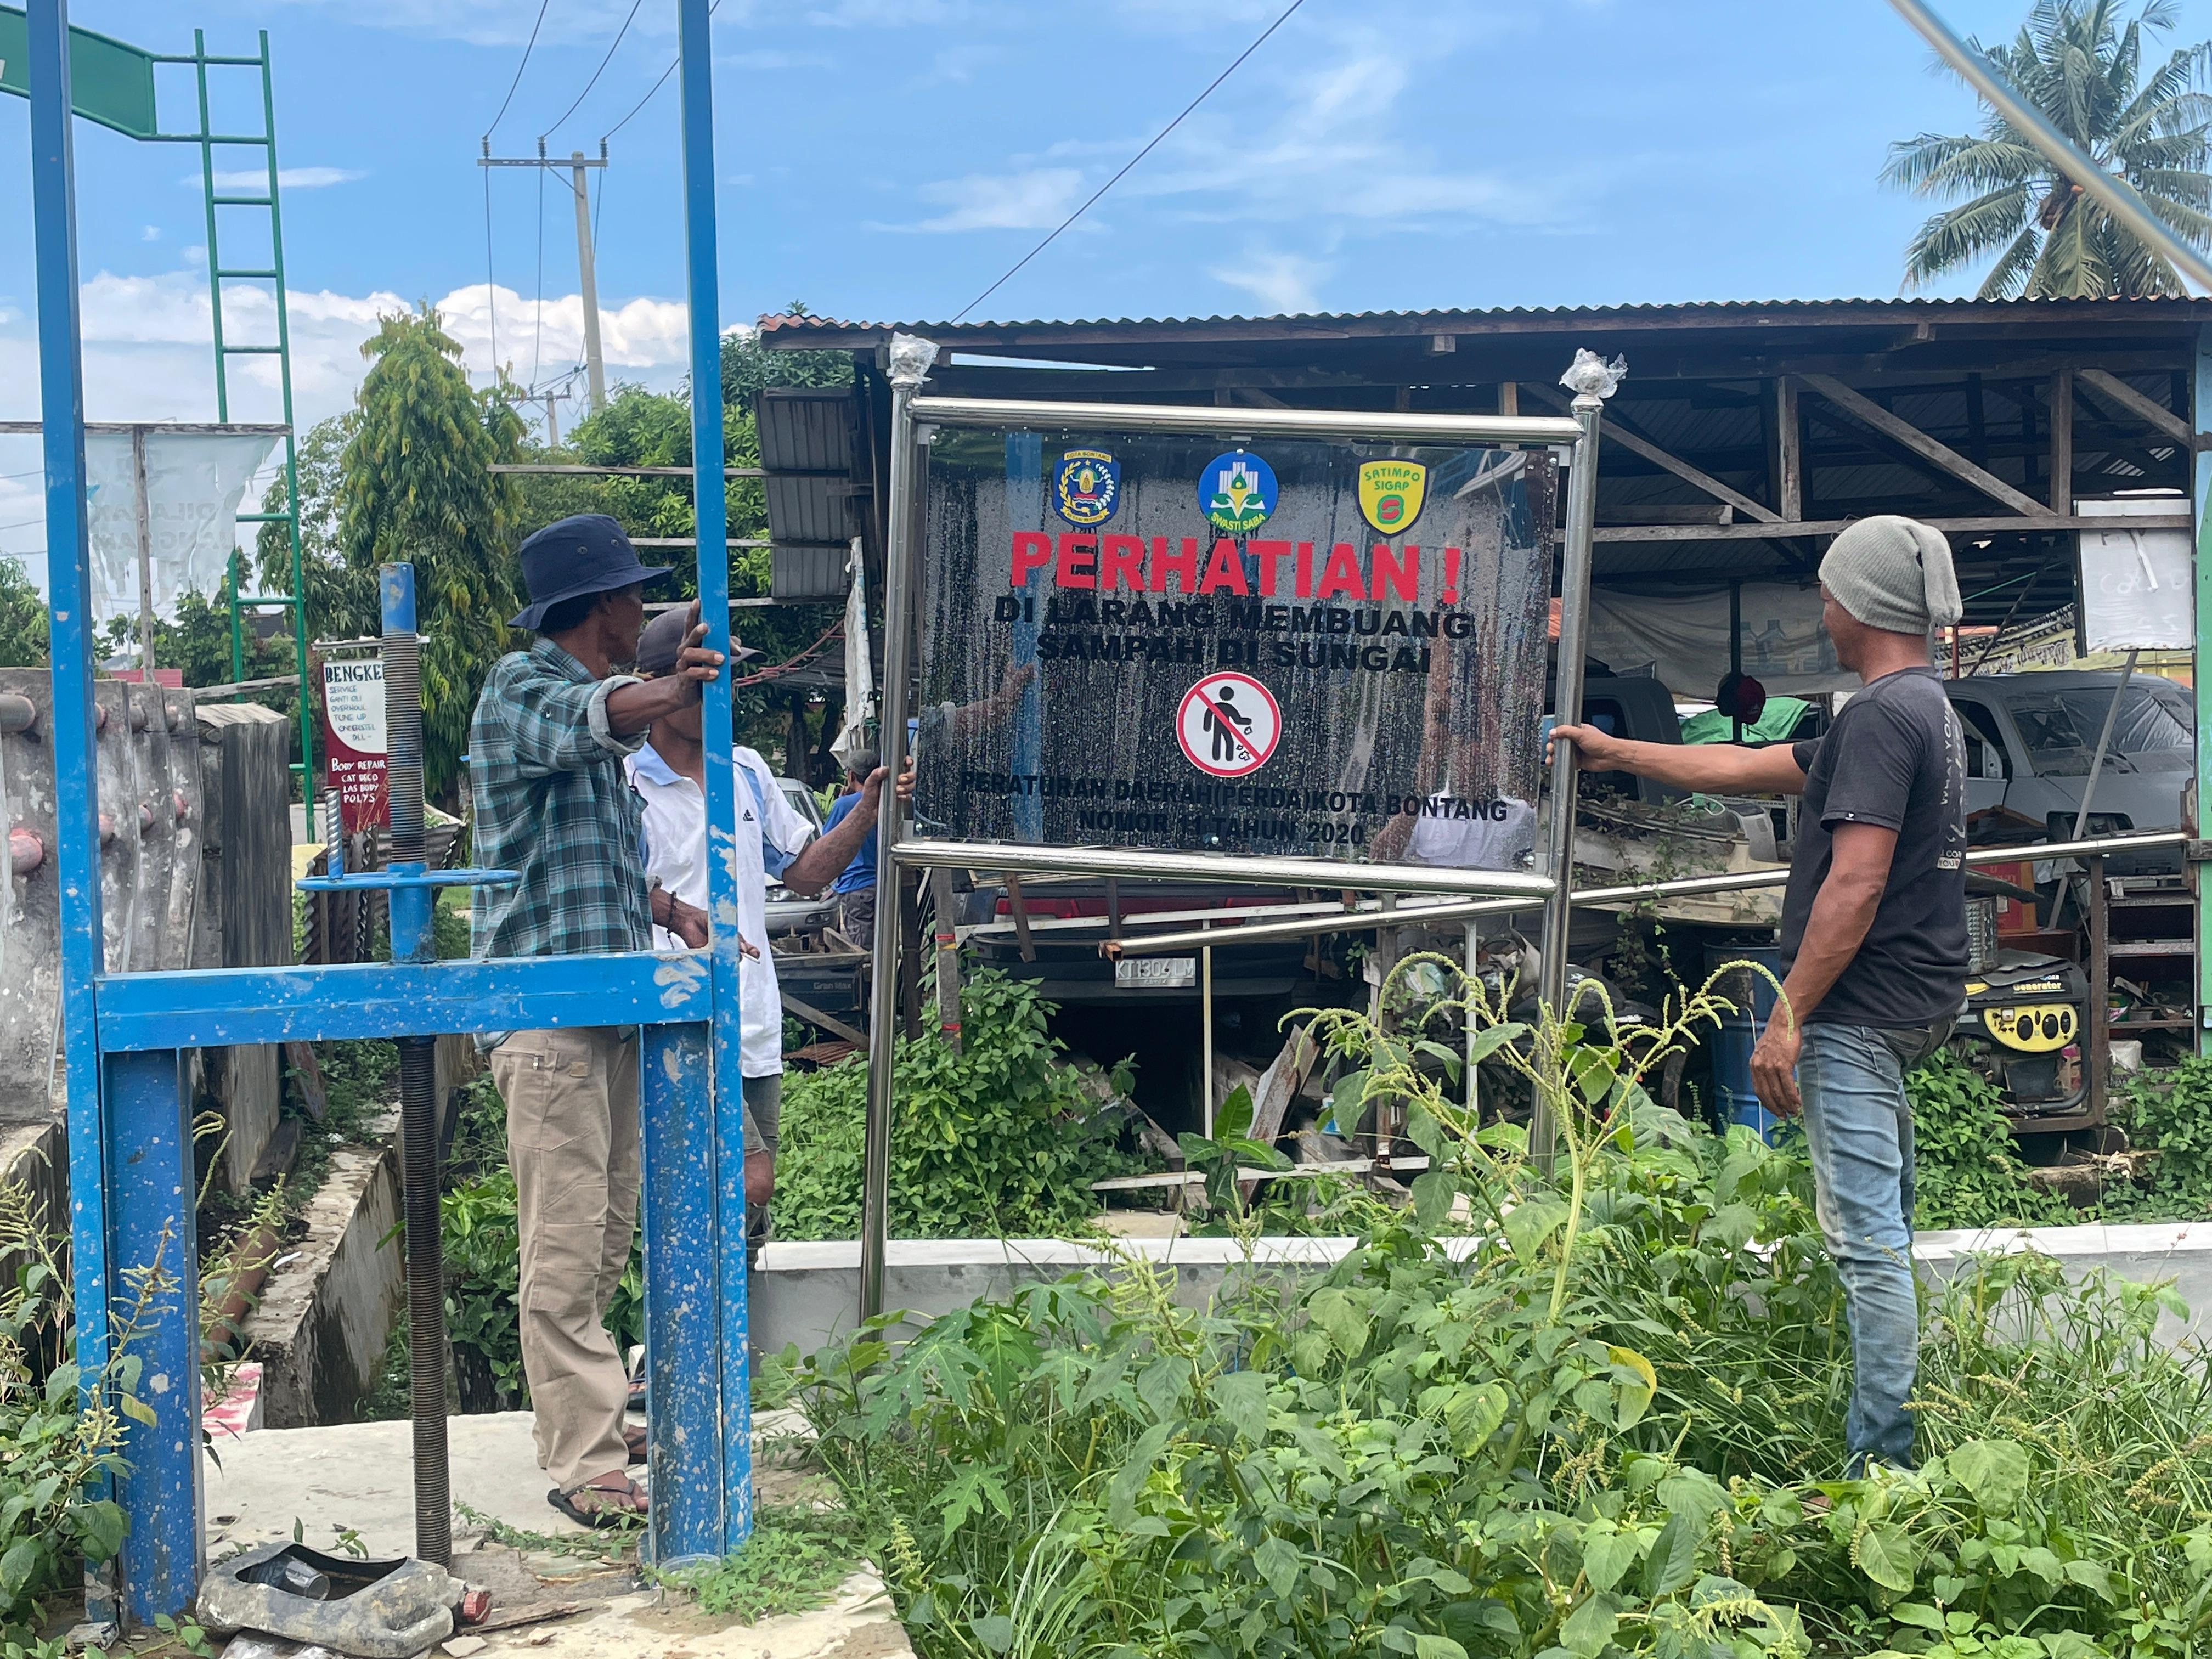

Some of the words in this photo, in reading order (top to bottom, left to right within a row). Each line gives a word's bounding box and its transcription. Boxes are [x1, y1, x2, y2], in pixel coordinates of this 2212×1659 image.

[1364, 467, 1420, 481] SATIMPO
[1374, 481, 1409, 491] SIGAP
[1211, 511, 1241, 531] SWASTI
[1243, 512, 1266, 531] SABA
[1011, 531, 1420, 602] PERHATIAN
[1443, 548, 1460, 604] !
[995, 596, 1033, 623] DI
[1048, 598, 1214, 628] LARANG
[1229, 605, 1476, 639] MEMBUANG
[1036, 634, 1204, 664] SAMPAH
[1217, 639, 1259, 665] DI
[1274, 642, 1430, 674] SUNGAI
[357, 759, 386, 770] REPAIR
[341, 774, 356, 783] CAT
[342, 784, 358, 793] LAS
[961, 771, 1106, 800] PERATURAN
[1386, 795, 1508, 821] BONTANG
[343, 793, 375, 804] POLYS
[1079, 810, 1169, 833] NOMOR
[1211, 817, 1296, 841] TAHUN
[1306, 822, 1364, 845] 2020
[1116, 960, 1133, 979] KT
